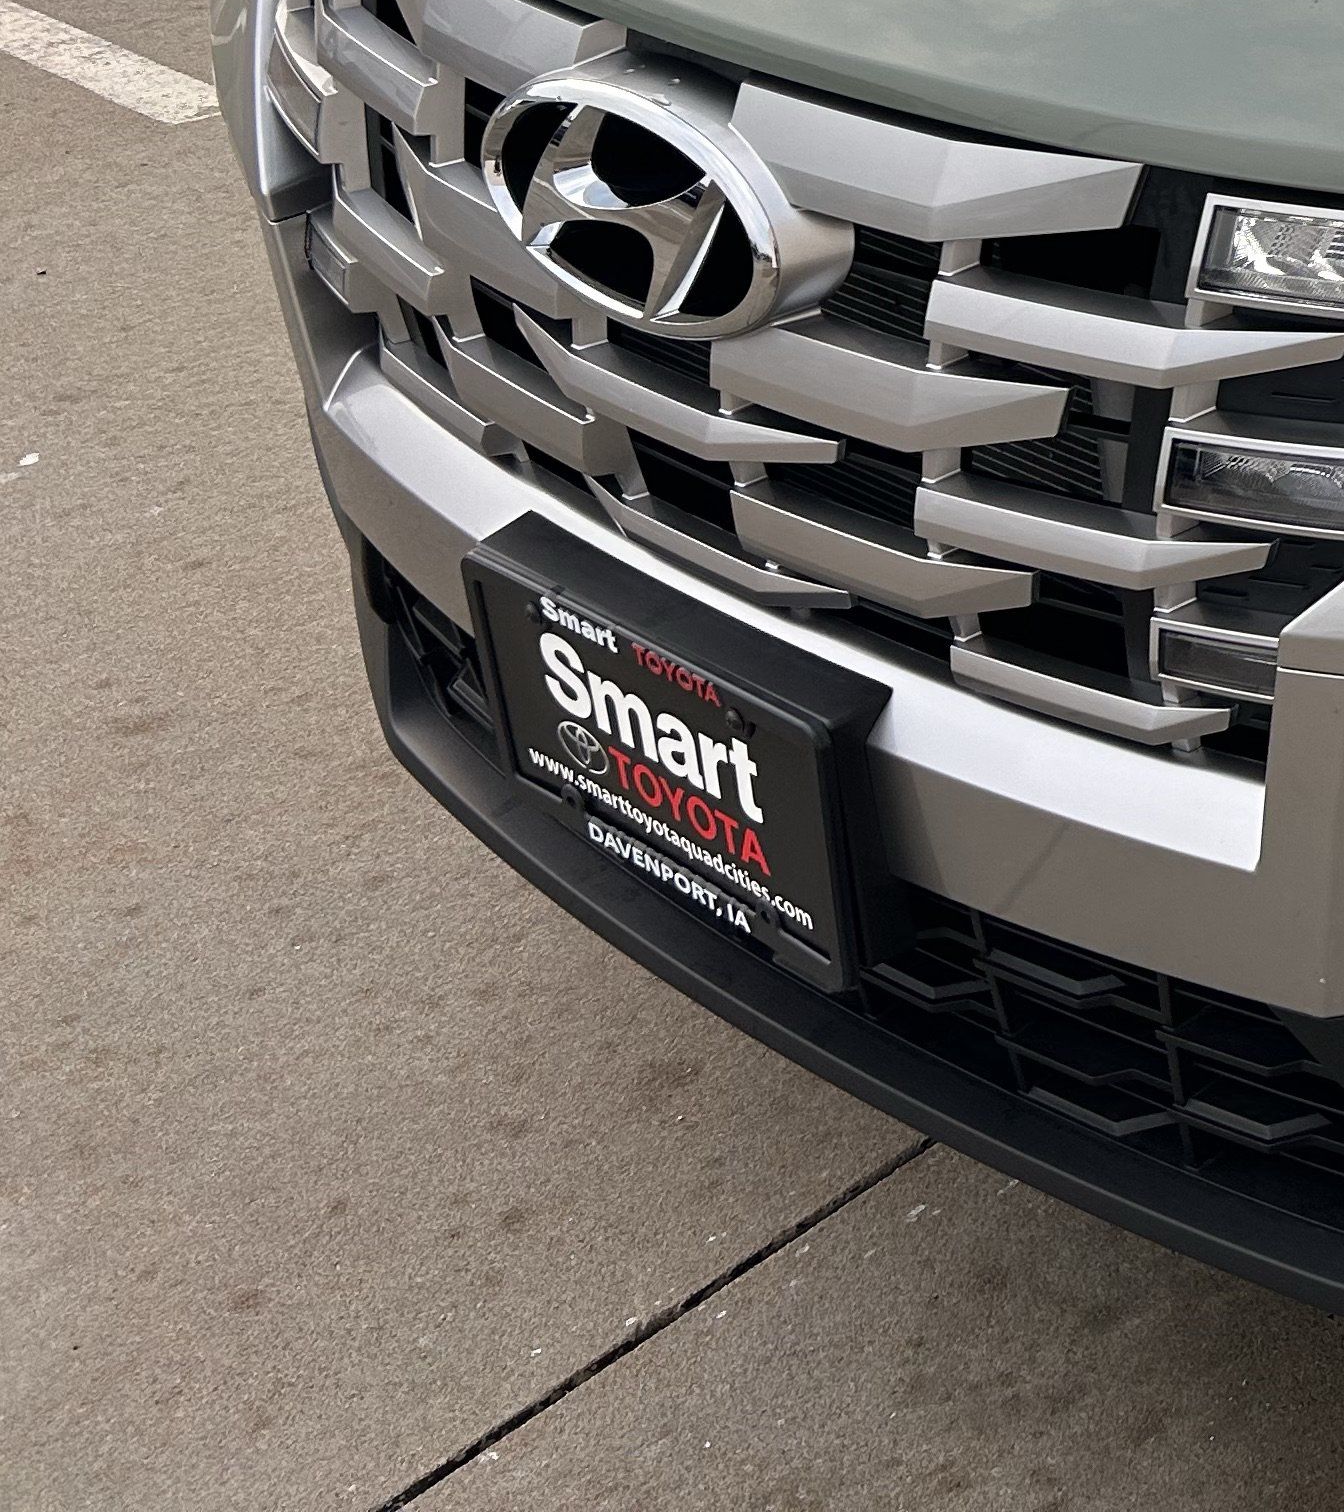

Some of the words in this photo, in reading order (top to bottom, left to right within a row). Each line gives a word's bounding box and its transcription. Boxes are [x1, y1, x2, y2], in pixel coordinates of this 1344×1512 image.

[538, 596, 619, 654] Smart
[631, 642, 720, 707] TOYOTA
[539, 631, 765, 824] Smart
[528, 747, 816, 931] www.smarttoyotaquadcities.com
[607, 745, 771, 876] TOYOTA
[587, 819, 724, 918] DAVENPORT,
[725, 896, 753, 934] IA
